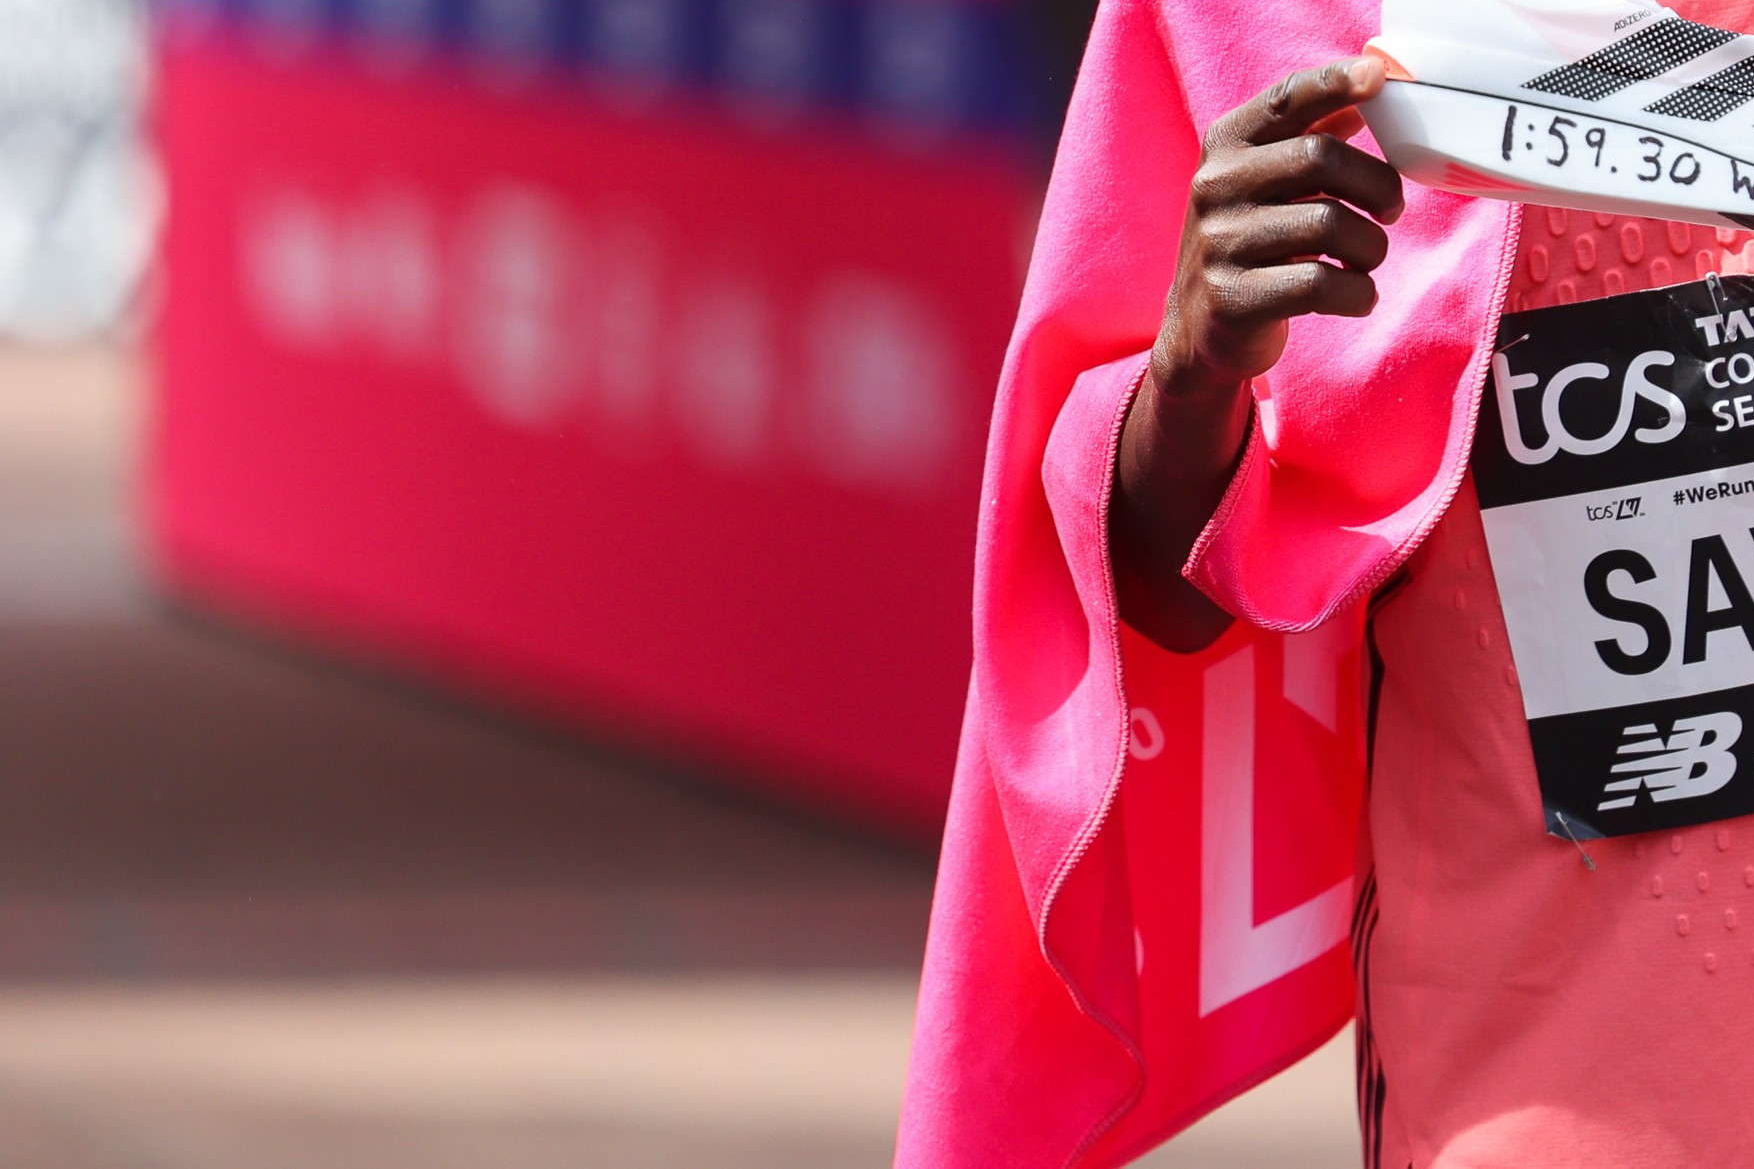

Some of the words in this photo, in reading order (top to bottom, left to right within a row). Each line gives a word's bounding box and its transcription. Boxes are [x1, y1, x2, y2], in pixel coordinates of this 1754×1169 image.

[1614, 9, 1652, 32] ADIZERO
[1501, 105, 1702, 186] 1:59.30
[1492, 350, 1687, 465] tcs
[1597, 710, 1743, 812] NB
